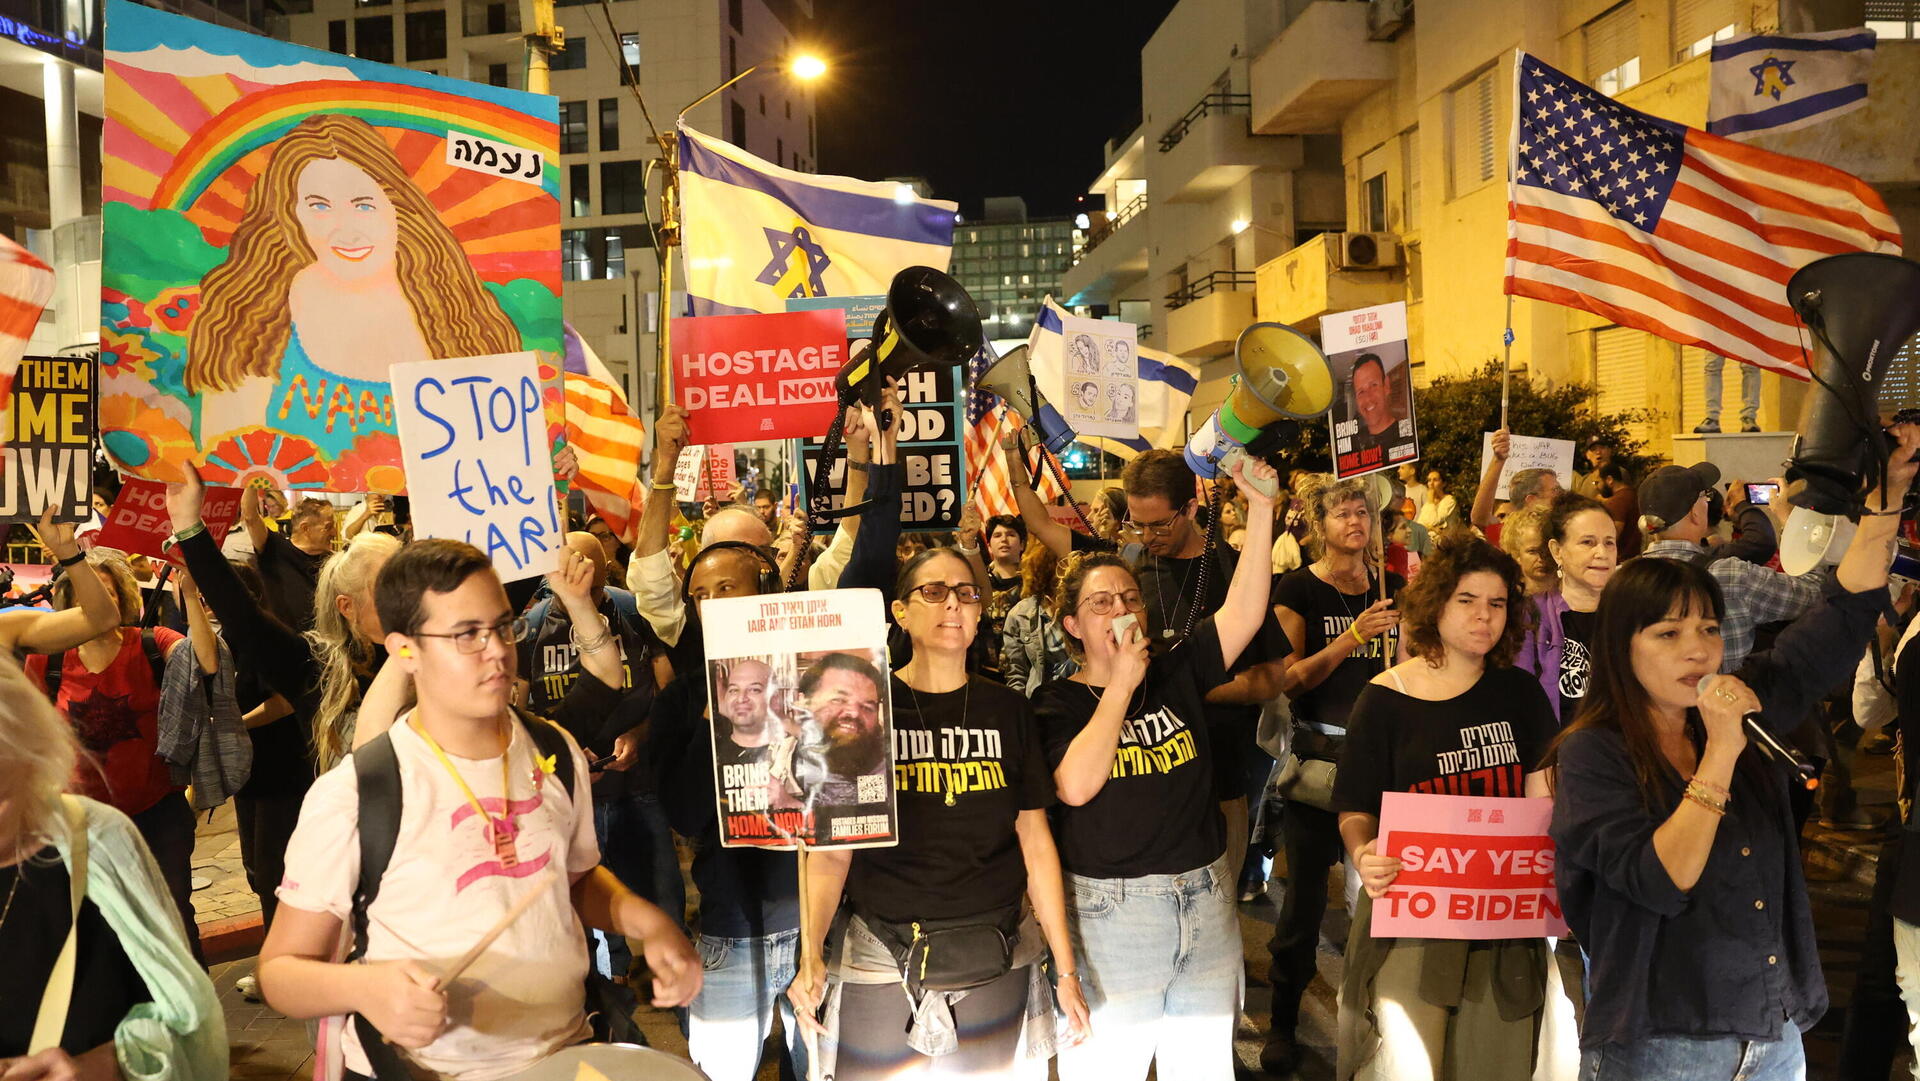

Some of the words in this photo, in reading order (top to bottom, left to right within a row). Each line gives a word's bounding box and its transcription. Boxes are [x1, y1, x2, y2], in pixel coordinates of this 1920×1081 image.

[455, 140, 541, 178] נעמה
[19, 360, 88, 389] THEM
[682, 345, 841, 378] HOSTAGE
[684, 383, 776, 411] DEAL
[783, 381, 837, 400] NOW
[414, 376, 540, 466] STOP
[1336, 419, 1359, 439] BRING
[1337, 437, 1352, 454] HIM
[1339, 452, 1360, 470] HOME
[1361, 445, 1383, 465] NOW!
[0, 447, 88, 516] OW!
[906, 455, 952, 486] BE
[448, 459, 535, 515] the
[125, 487, 236, 519] HOAGE
[114, 509, 174, 536] DEA
[464, 485, 560, 570] AR!
[760, 602, 779, 618] הורן
[807, 599, 828, 614] איתן
[747, 619, 766, 633] IAIR
[789, 616, 815, 630] EITAN
[817, 613, 842, 628] HORN
[1460, 721, 1514, 749] מחזירים
[1436, 747, 1481, 775] הביתה
[1482, 742, 1521, 768] אותם
[723, 763, 771, 788] BRING
[725, 787, 769, 812] THEM
[727, 814, 772, 836] HOME
[773, 810, 816, 836] NOW!
[831, 824, 864, 837] FAMILIES
[864, 822, 889, 834] FORUM
[1400, 845, 1477, 875] SAY
[1487, 849, 1555, 875] YES
[1383, 891, 1436, 919] TO
[1448, 893, 1562, 921] BIDEN
